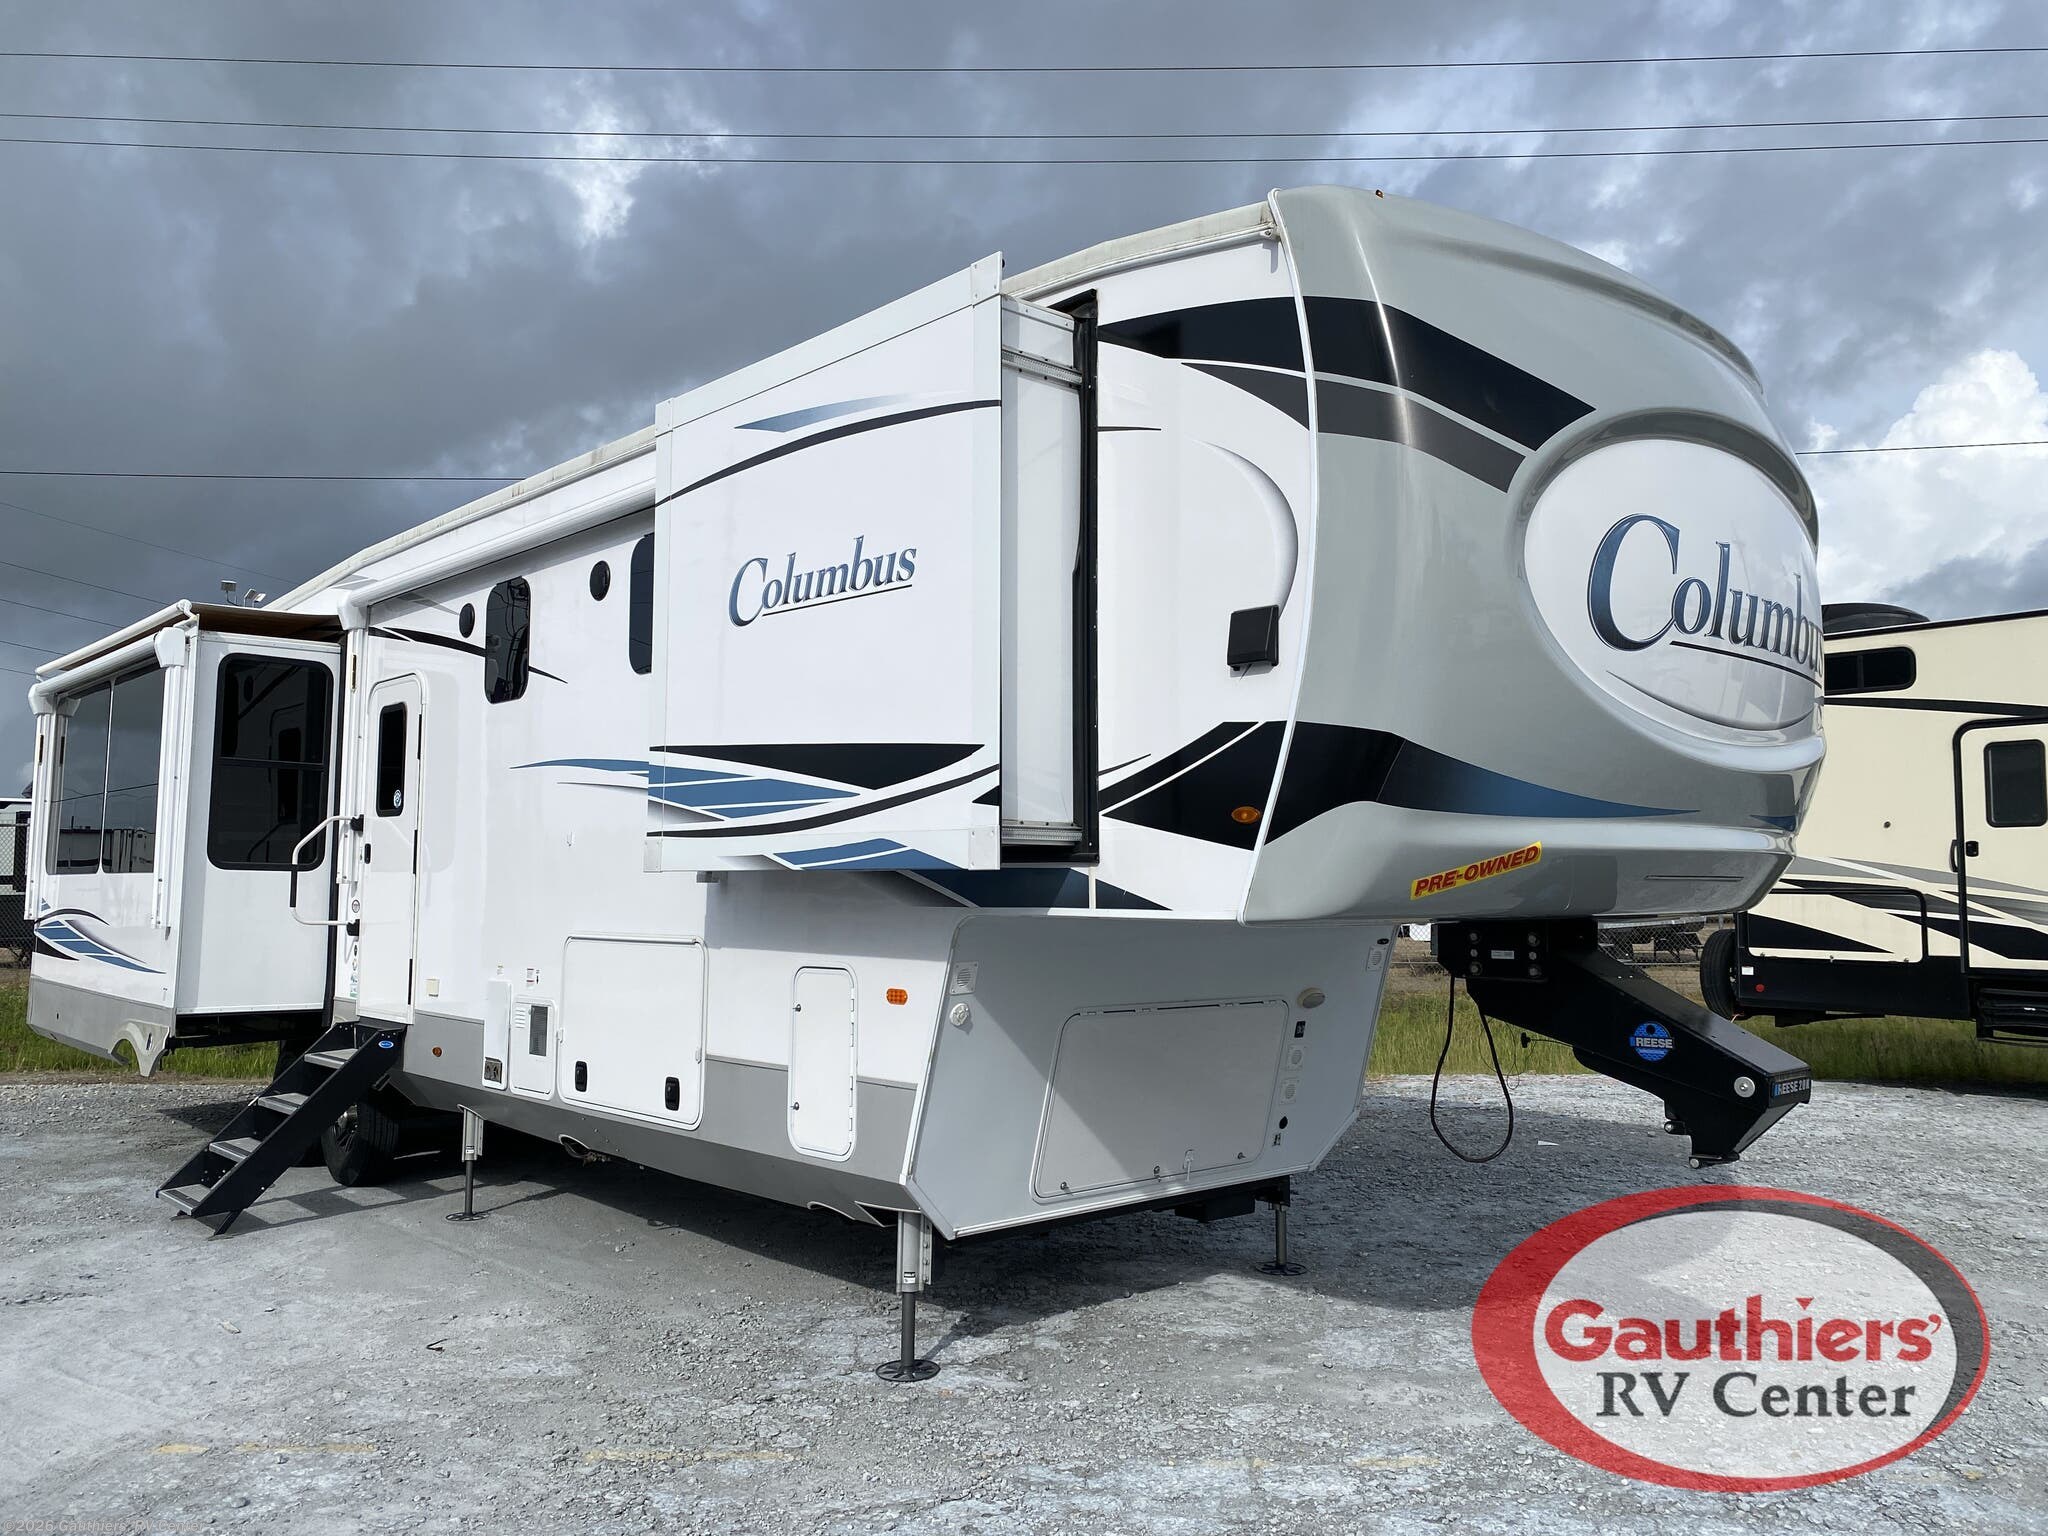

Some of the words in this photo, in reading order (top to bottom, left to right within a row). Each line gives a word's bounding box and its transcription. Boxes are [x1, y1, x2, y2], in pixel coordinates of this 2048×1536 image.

[728, 534, 917, 627] Columbus
[1414, 845, 1539, 898] PRE-OWNED
[1635, 1037, 1673, 1049] REESE
